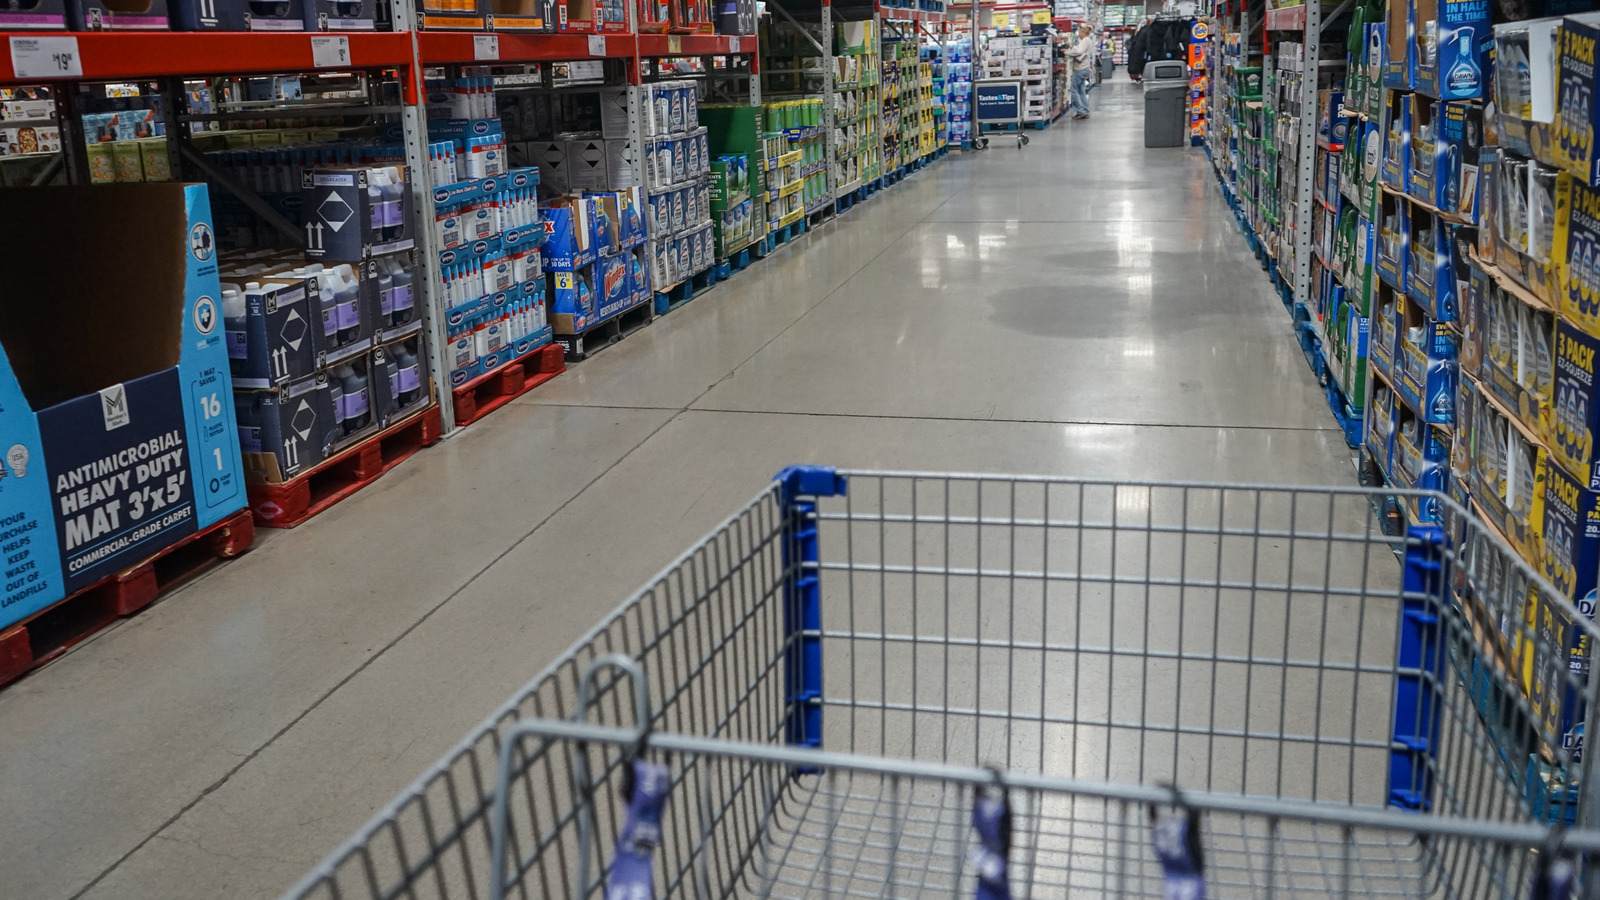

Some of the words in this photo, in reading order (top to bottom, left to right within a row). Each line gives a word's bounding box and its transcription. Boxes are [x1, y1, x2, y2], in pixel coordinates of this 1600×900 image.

[1446, 13, 1463, 22] THE
[1465, 11, 1487, 20] TIME
[1447, 4, 1458, 13] IN
[1461, 1, 1487, 12] HALF
[1564, 30, 1571, 54] 3
[1572, 32, 1596, 65] PACK
[1574, 185, 1581, 209] 3
[1583, 190, 1600, 220] PAC
[1573, 210, 1600, 234] EZ-SQUEE
[605, 264, 626, 301] Windex
[1435, 336, 1446, 344] IN
[1559, 332, 1565, 355] 3
[1566, 337, 1595, 374] PACK
[199, 376, 216, 387] SAVES:
[204, 367, 215, 377] MAT
[1558, 356, 1593, 386] EZ-SQUEEZE
[201, 392, 221, 420] 16
[56, 430, 182, 493] ANTIMICROBIAL
[213, 448, 222, 471] 1
[60, 470, 132, 516] HEAVY
[136, 448, 183, 484] DUTY
[1548, 466, 1553, 488] 3
[1554, 472, 1579, 512] PACK
[65, 504, 120, 551] MAT
[128, 470, 186, 520] 3'x5'
[1546, 489, 1577, 524] EZ-SQUEEZE
[1587, 511, 1600, 519] PA
[0, 512, 25, 528] YOUR
[3, 536, 31, 553] HELPS
[69, 515, 162, 572] COMMERCIAL-GRADE
[162, 505, 192, 525] CARPET
[5, 560, 36, 579] WASTE
[7, 550, 30, 565] KEEP
[6, 578, 25, 592] OUT
[27, 571, 39, 582] OF
[1, 581, 48, 608] LANDFILLS
